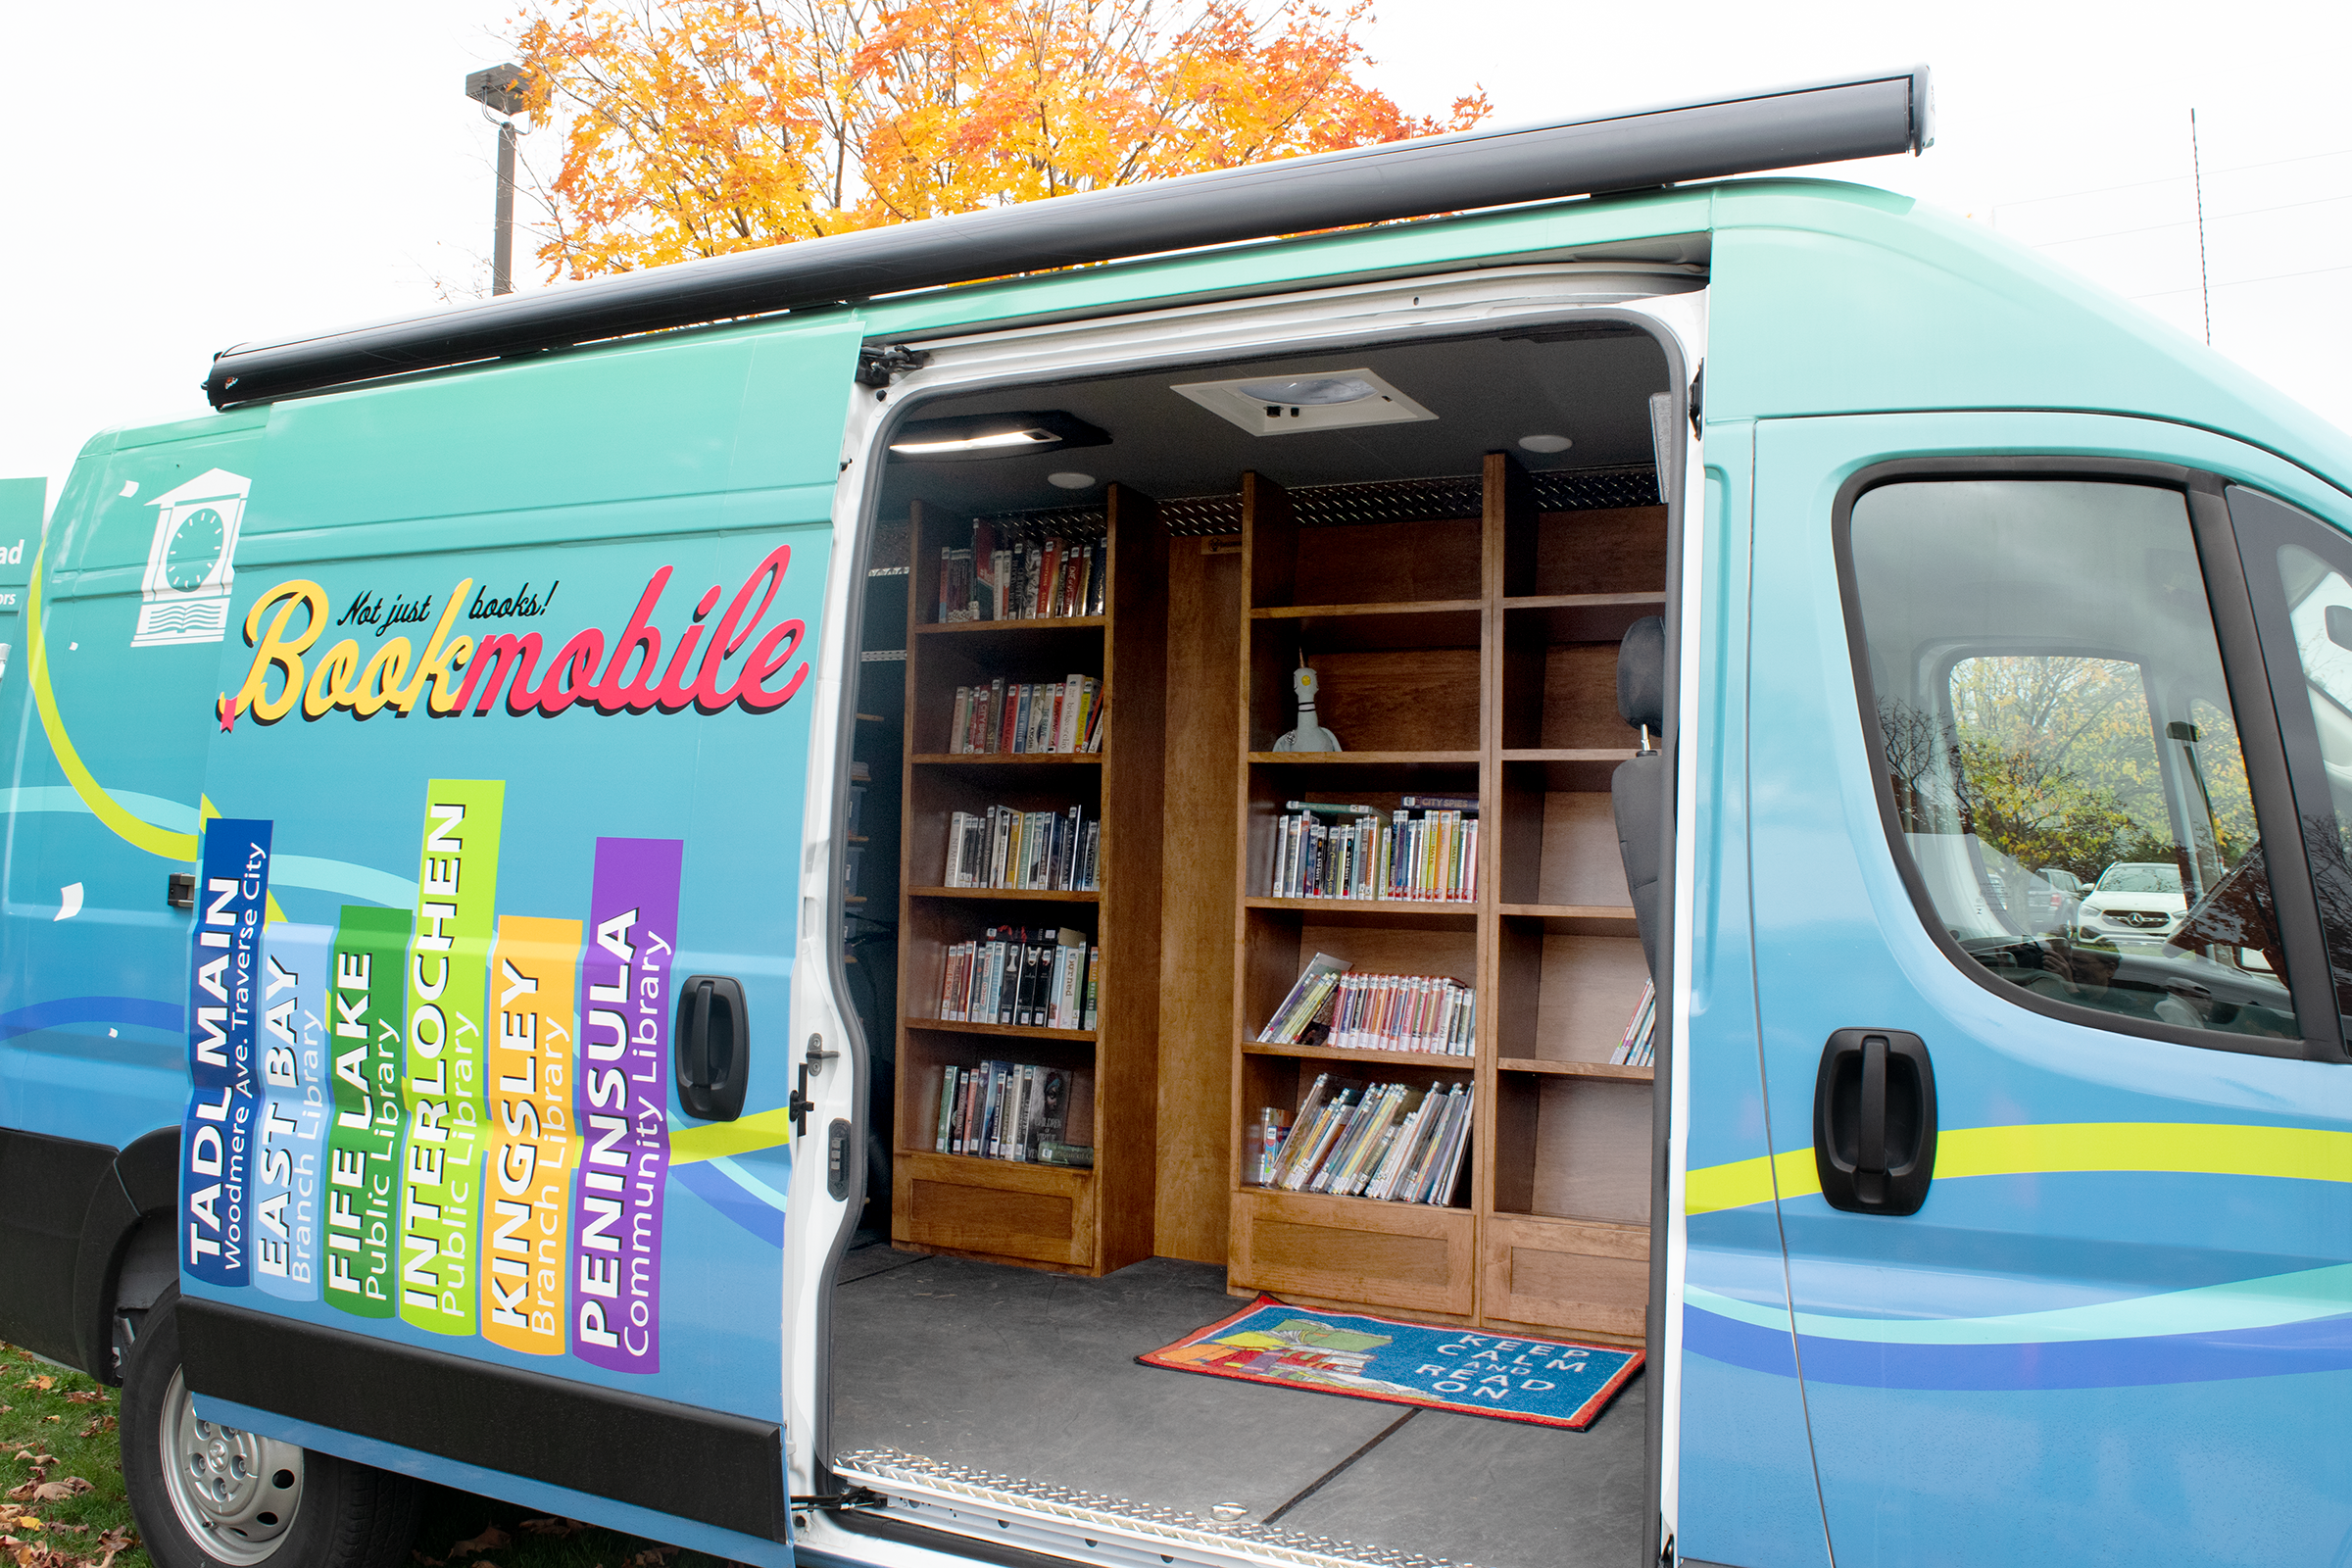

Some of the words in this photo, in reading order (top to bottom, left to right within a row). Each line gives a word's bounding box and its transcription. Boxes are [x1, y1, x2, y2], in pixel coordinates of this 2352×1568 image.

[218, 543, 811, 727] Bookmobile
[337, 590, 384, 627] Not
[378, 593, 431, 637] just
[467, 580, 560, 619] books!
[977, 723, 986, 745] SPIES
[979, 704, 988, 722] CITY
[1040, 719, 1049, 737] BRAVE
[1053, 700, 1061, 732] PUNCHING
[1060, 734, 1069, 750] clay
[1064, 702, 1075, 726] bridge
[948, 837, 958, 877] NEMESIS
[1085, 841, 1095, 887] DIVERGENT
[1422, 798, 1444, 807] CITY
[243, 842, 267, 898] City
[197, 877, 241, 1067] MAIN
[233, 903, 259, 1033] Traverse
[263, 956, 299, 1089] BAY
[631, 931, 674, 1084] Library
[231, 1047, 251, 1099] Ave.
[298, 1009, 325, 1142] Library
[335, 951, 372, 1131] LAKE
[370, 1018, 400, 1162] Library
[403, 803, 466, 1309] INTERLOCHEN
[449, 1011, 480, 1164] Library
[540, 1017, 570, 1171] Library
[190, 1084, 233, 1266] TADL
[223, 1105, 251, 1270] Woodmere
[257, 1102, 296, 1279] EAST
[492, 957, 539, 1330] KINGSLEY
[579, 906, 641, 1348] PENINSULA
[290, 1167, 315, 1284] Branch
[328, 1149, 367, 1295] FIFE
[365, 1174, 393, 1299] Public
[441, 1175, 469, 1317] Public
[531, 1187, 562, 1337] Branch
[622, 1096, 663, 1357] Community
[1415, 1363, 1555, 1391] READ
[1432, 1380, 1509, 1399] ON
[1437, 1344, 1587, 1373] CALM
[1458, 1334, 1590, 1358] KEEP
[1464, 1361, 1531, 1375] AND
